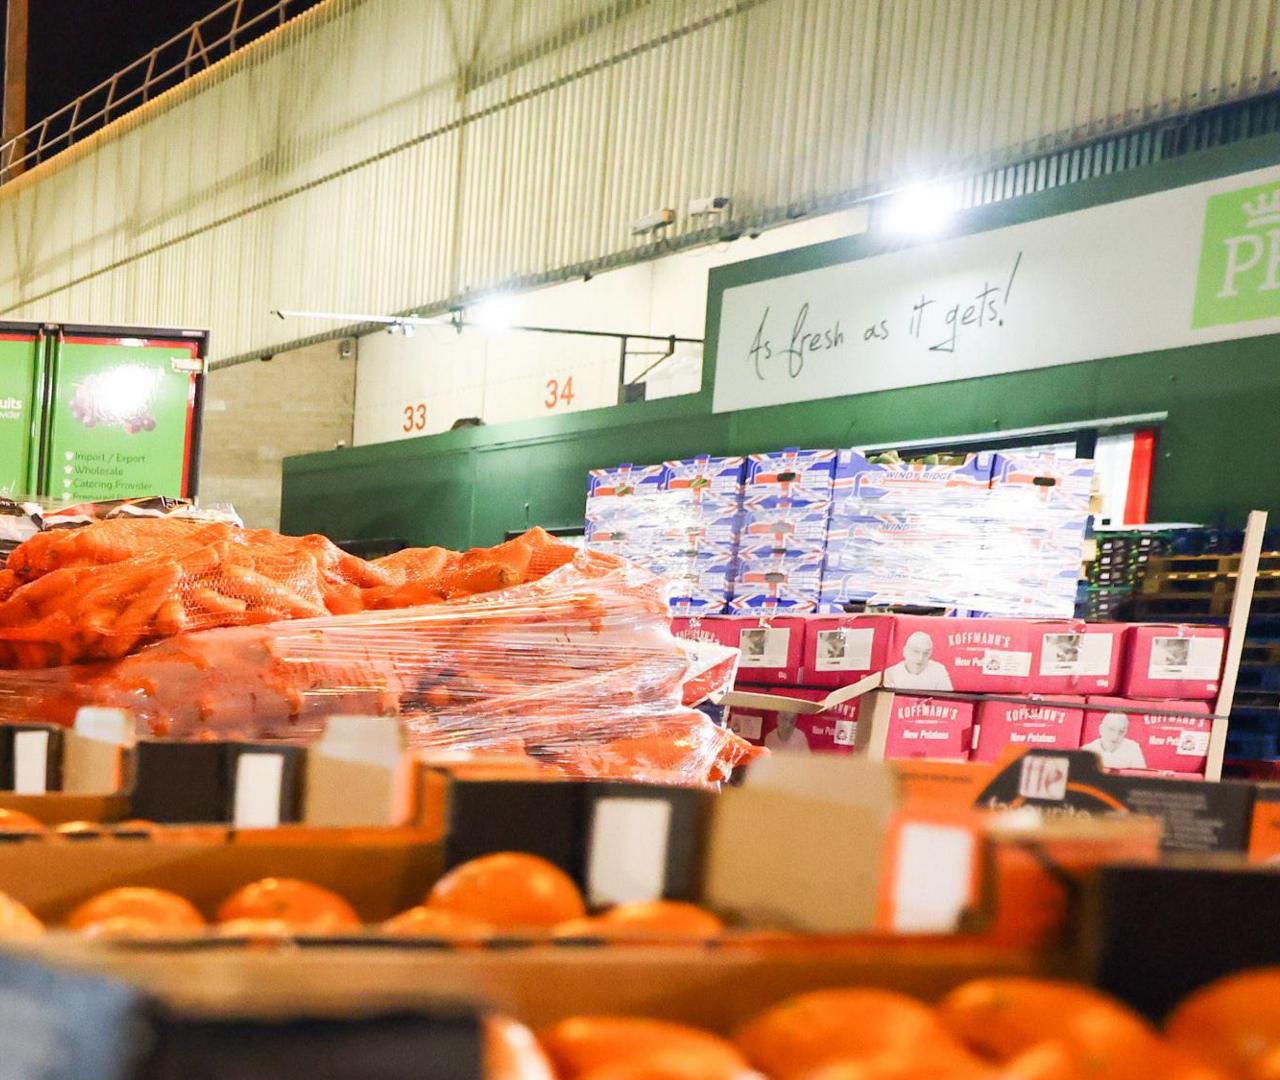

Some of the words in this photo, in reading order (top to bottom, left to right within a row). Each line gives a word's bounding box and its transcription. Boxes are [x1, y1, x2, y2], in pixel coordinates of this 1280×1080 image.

[747, 305, 772, 381] As
[781, 302, 844, 379] fresh
[863, 319, 890, 342] as
[909, 294, 933, 338] it
[928, 250, 1023, 353] gets!
[544, 376, 575, 409] 34
[402, 403, 428, 433] 33
[75, 452, 105, 462] Import
[116, 453, 146, 464] Export
[75, 465, 123, 476] Wholesale
[885, 471, 919, 481] WINDY
[923, 471, 953, 481] RIDGE
[73, 478, 112, 490] Catering
[948, 631, 1012, 648] KOFFMANN'S
[897, 705, 959, 720] KOFFMANN'S
